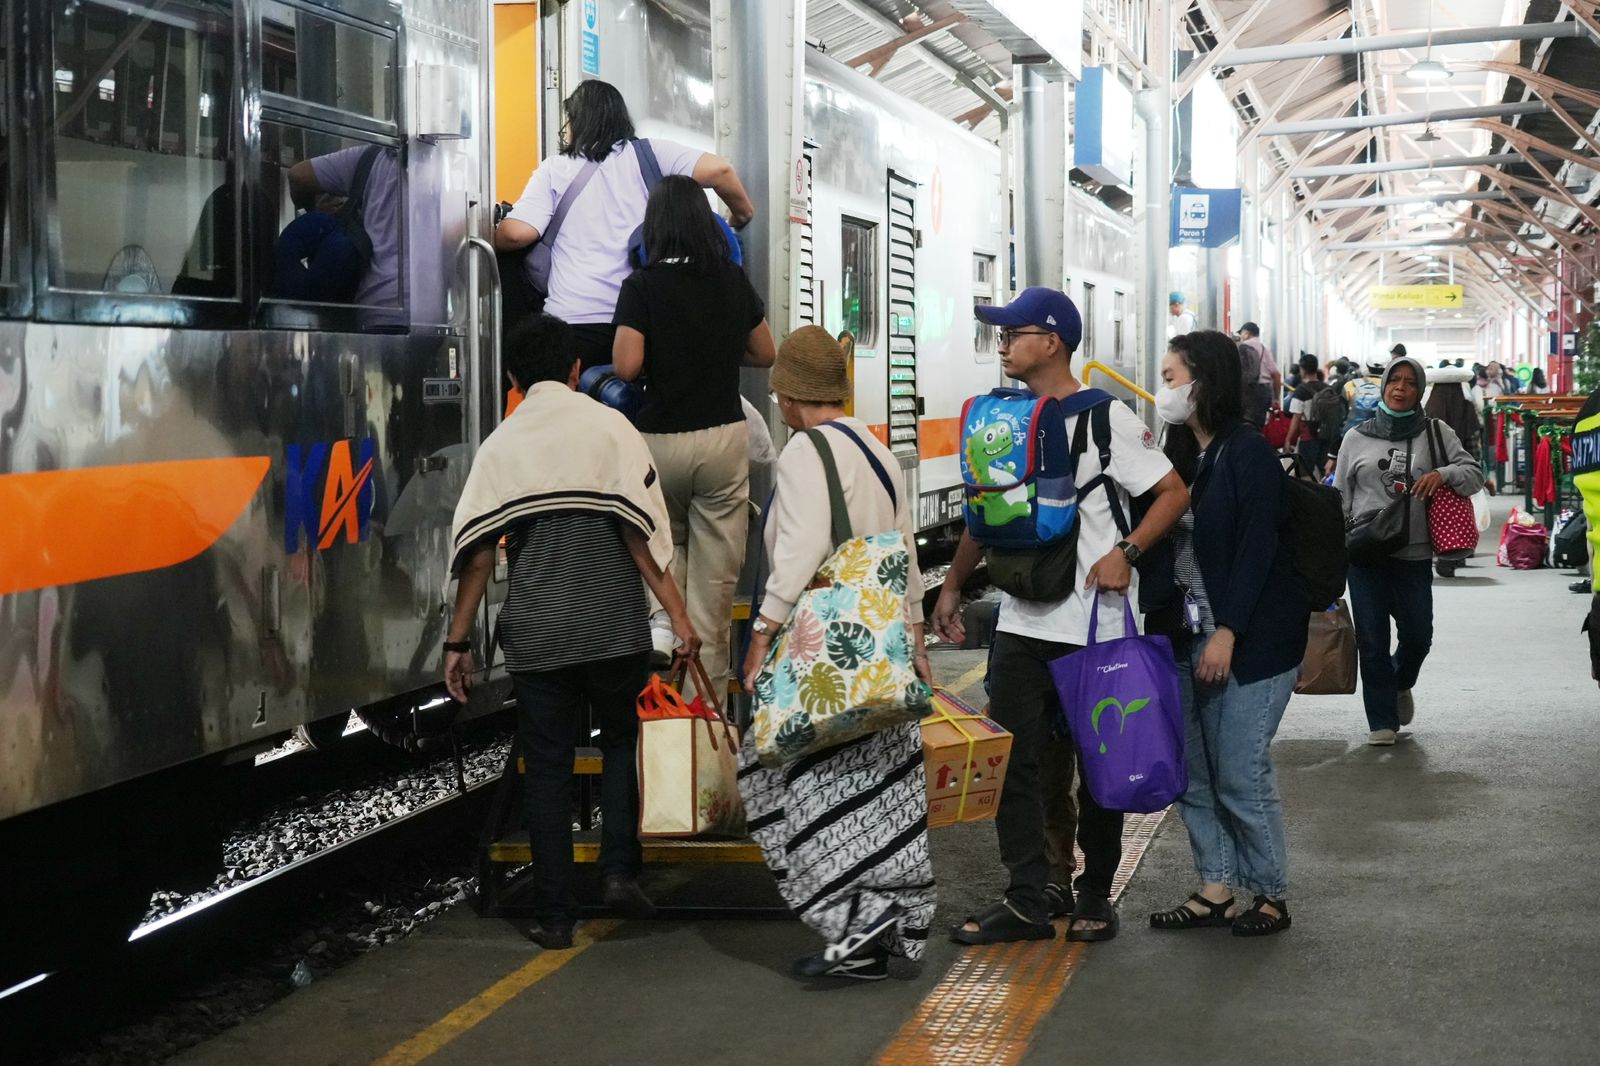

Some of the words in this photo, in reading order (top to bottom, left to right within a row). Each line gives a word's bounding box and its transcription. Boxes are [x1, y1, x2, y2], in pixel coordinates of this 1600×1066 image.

[1179, 229, 1200, 237] Peron
[1201, 229, 1206, 237] 1
[285, 437, 375, 554] KAI
[978, 795, 991, 806] KG
